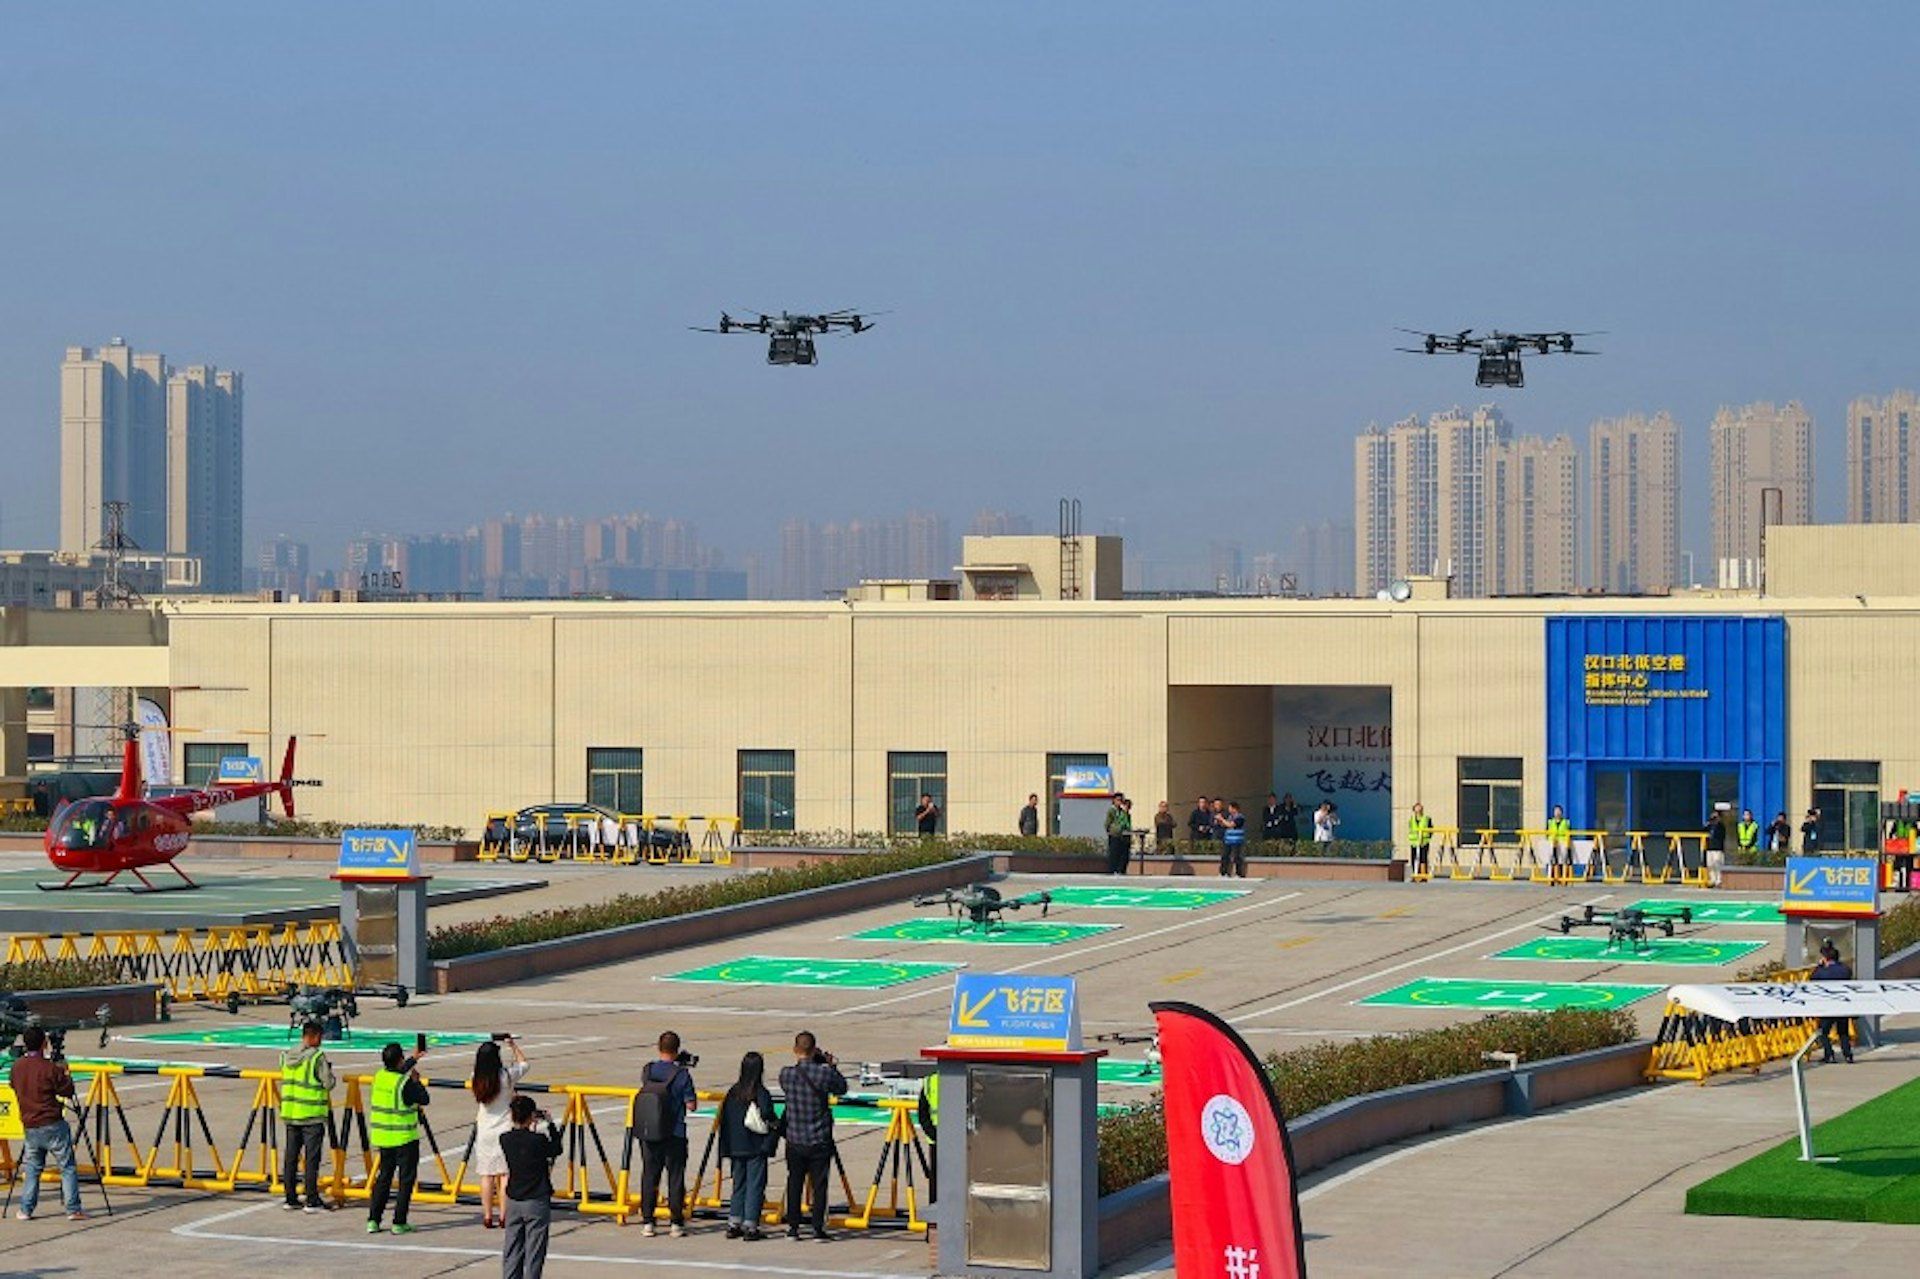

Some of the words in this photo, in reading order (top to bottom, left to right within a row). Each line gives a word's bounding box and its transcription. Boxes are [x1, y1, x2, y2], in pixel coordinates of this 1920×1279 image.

[1585, 653, 1685, 671] 汉口北低空港
[1585, 672, 1648, 689] 指挥中心
[1819, 866, 1871, 885] 飞行区
[998, 986, 1067, 1013] 飞行区
